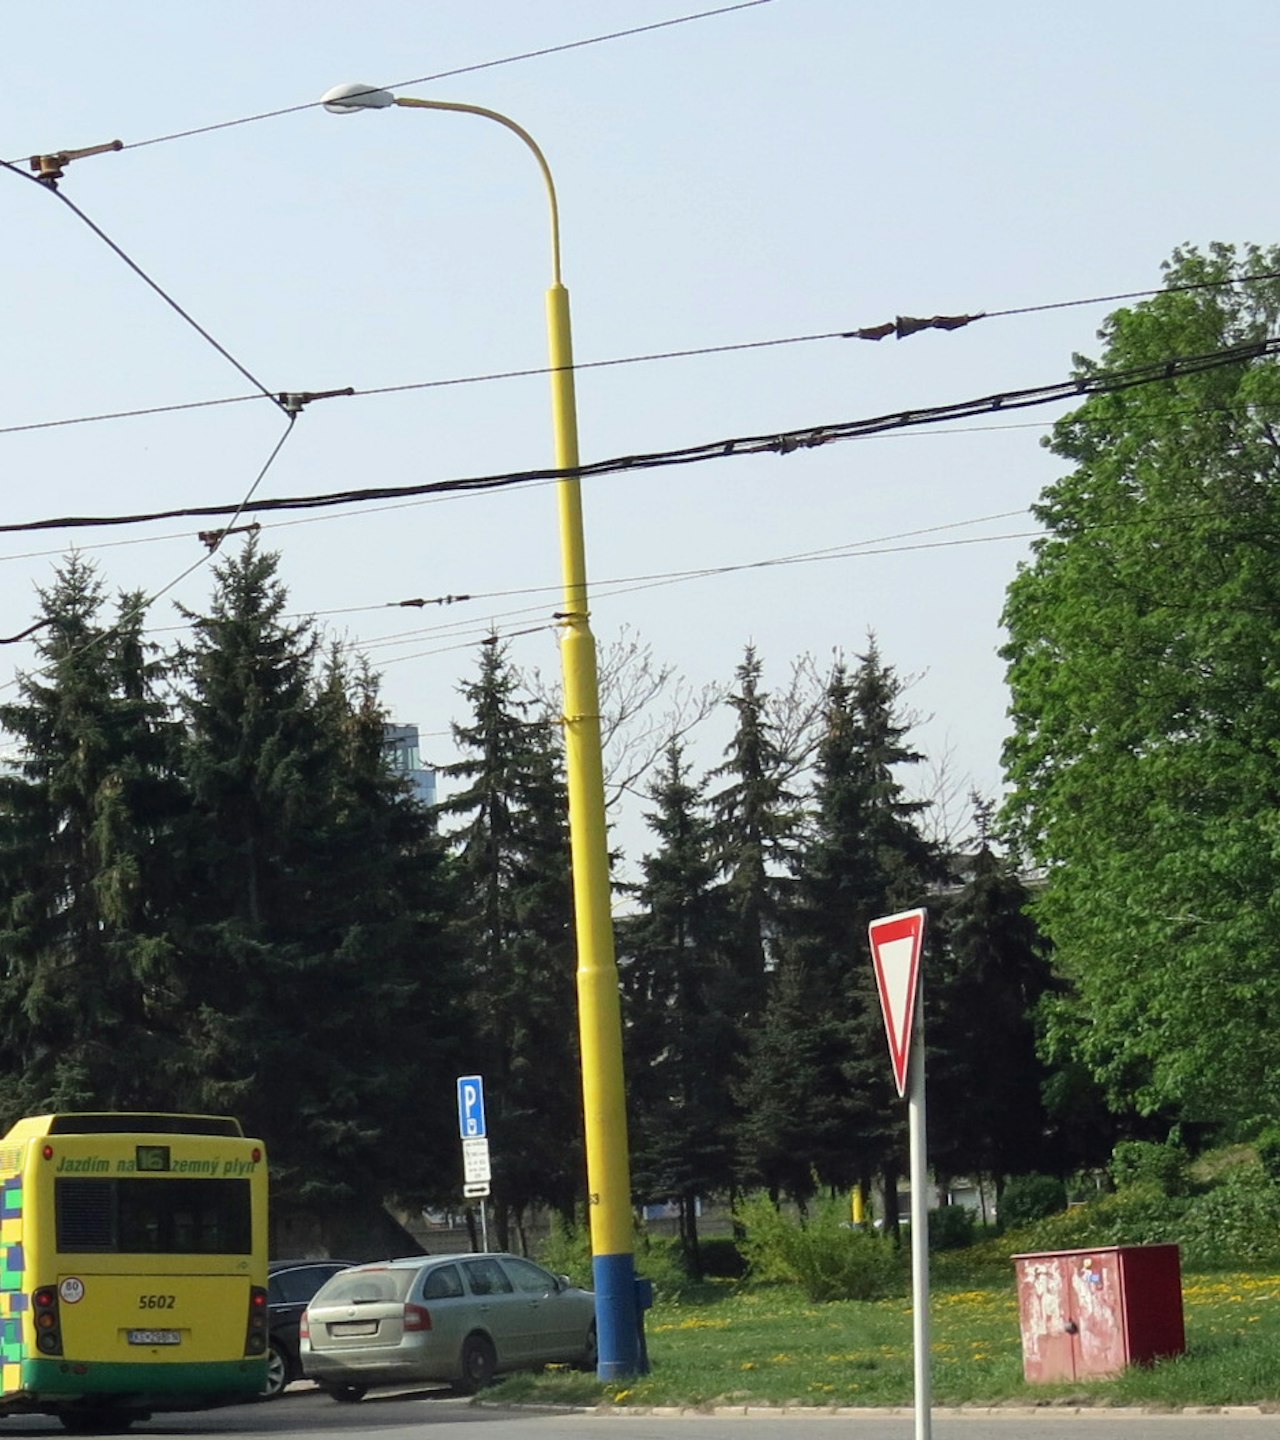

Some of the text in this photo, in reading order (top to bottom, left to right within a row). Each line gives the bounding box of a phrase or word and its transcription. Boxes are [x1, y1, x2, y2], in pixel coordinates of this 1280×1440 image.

[463, 1084, 476, 1119] P
[56, 1155, 256, 1176] Jazdím na zemný plyn
[65, 1281, 79, 1291] 80
[139, 1295, 177, 1309] 5602
